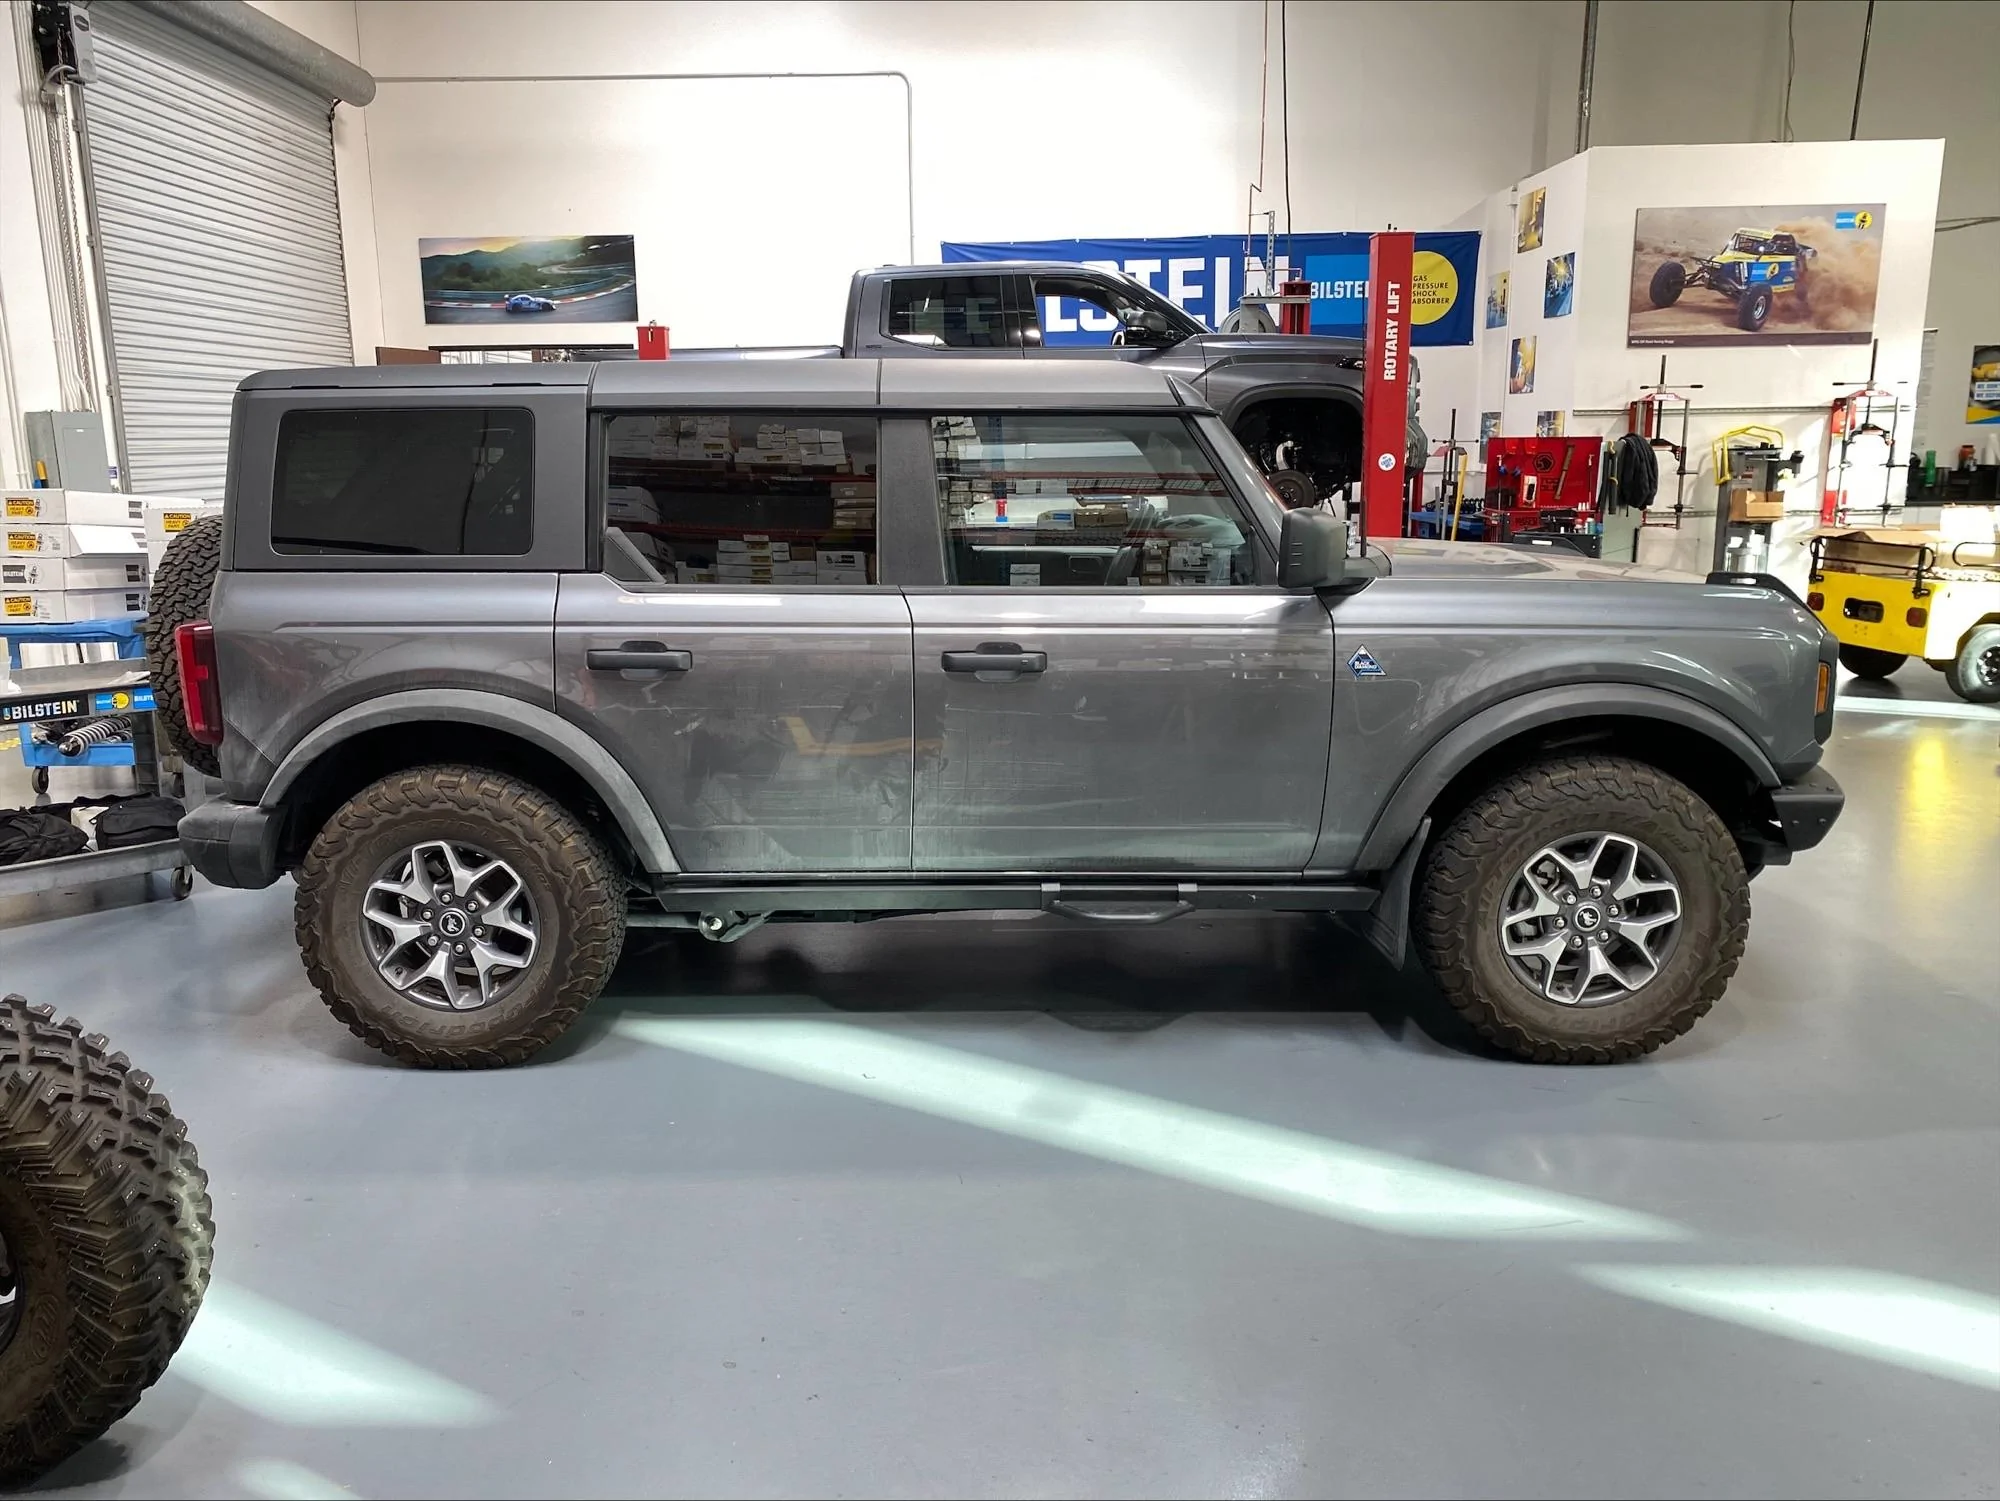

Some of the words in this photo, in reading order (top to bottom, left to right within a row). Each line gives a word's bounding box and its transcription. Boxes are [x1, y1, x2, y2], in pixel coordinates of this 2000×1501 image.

[1412, 282, 1449, 290] PRESSURE
[1387, 280, 1401, 314] LIFT
[1411, 297, 1450, 305] ABSORBER
[1383, 318, 1399, 381] ROTARY
[11, 699, 78, 720] BILSTEIN
